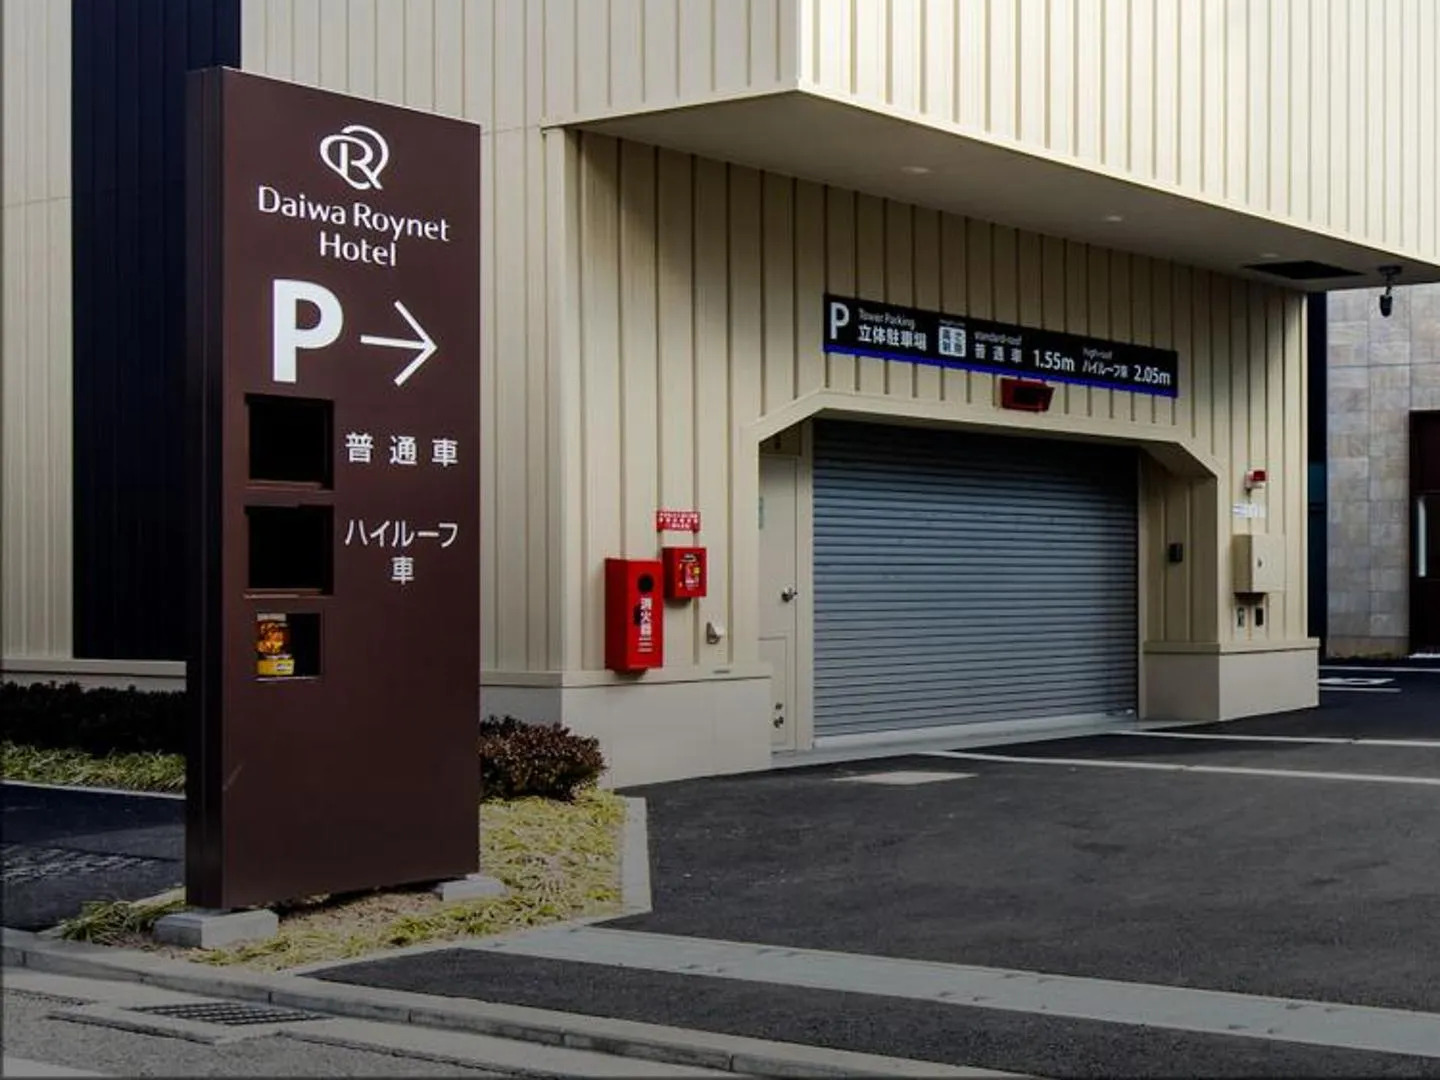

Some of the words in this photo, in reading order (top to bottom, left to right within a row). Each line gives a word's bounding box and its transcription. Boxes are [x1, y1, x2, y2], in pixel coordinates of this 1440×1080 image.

[258, 184, 346, 225] Daiwa
[353, 202, 450, 242] Roynet
[319, 230, 398, 267] Hotel
[273, 279, 343, 383] P
[830, 302, 849, 340] P
[884, 311, 916, 330] Parking
[858, 324, 928, 352] 立体駐車場
[1033, 349, 1075, 372] 1.55m
[1134, 364, 1171, 386] 2.05m
[345, 432, 459, 467] 普通車
[344, 519, 459, 548] ハイルーフ
[391, 556, 415, 585] 車
